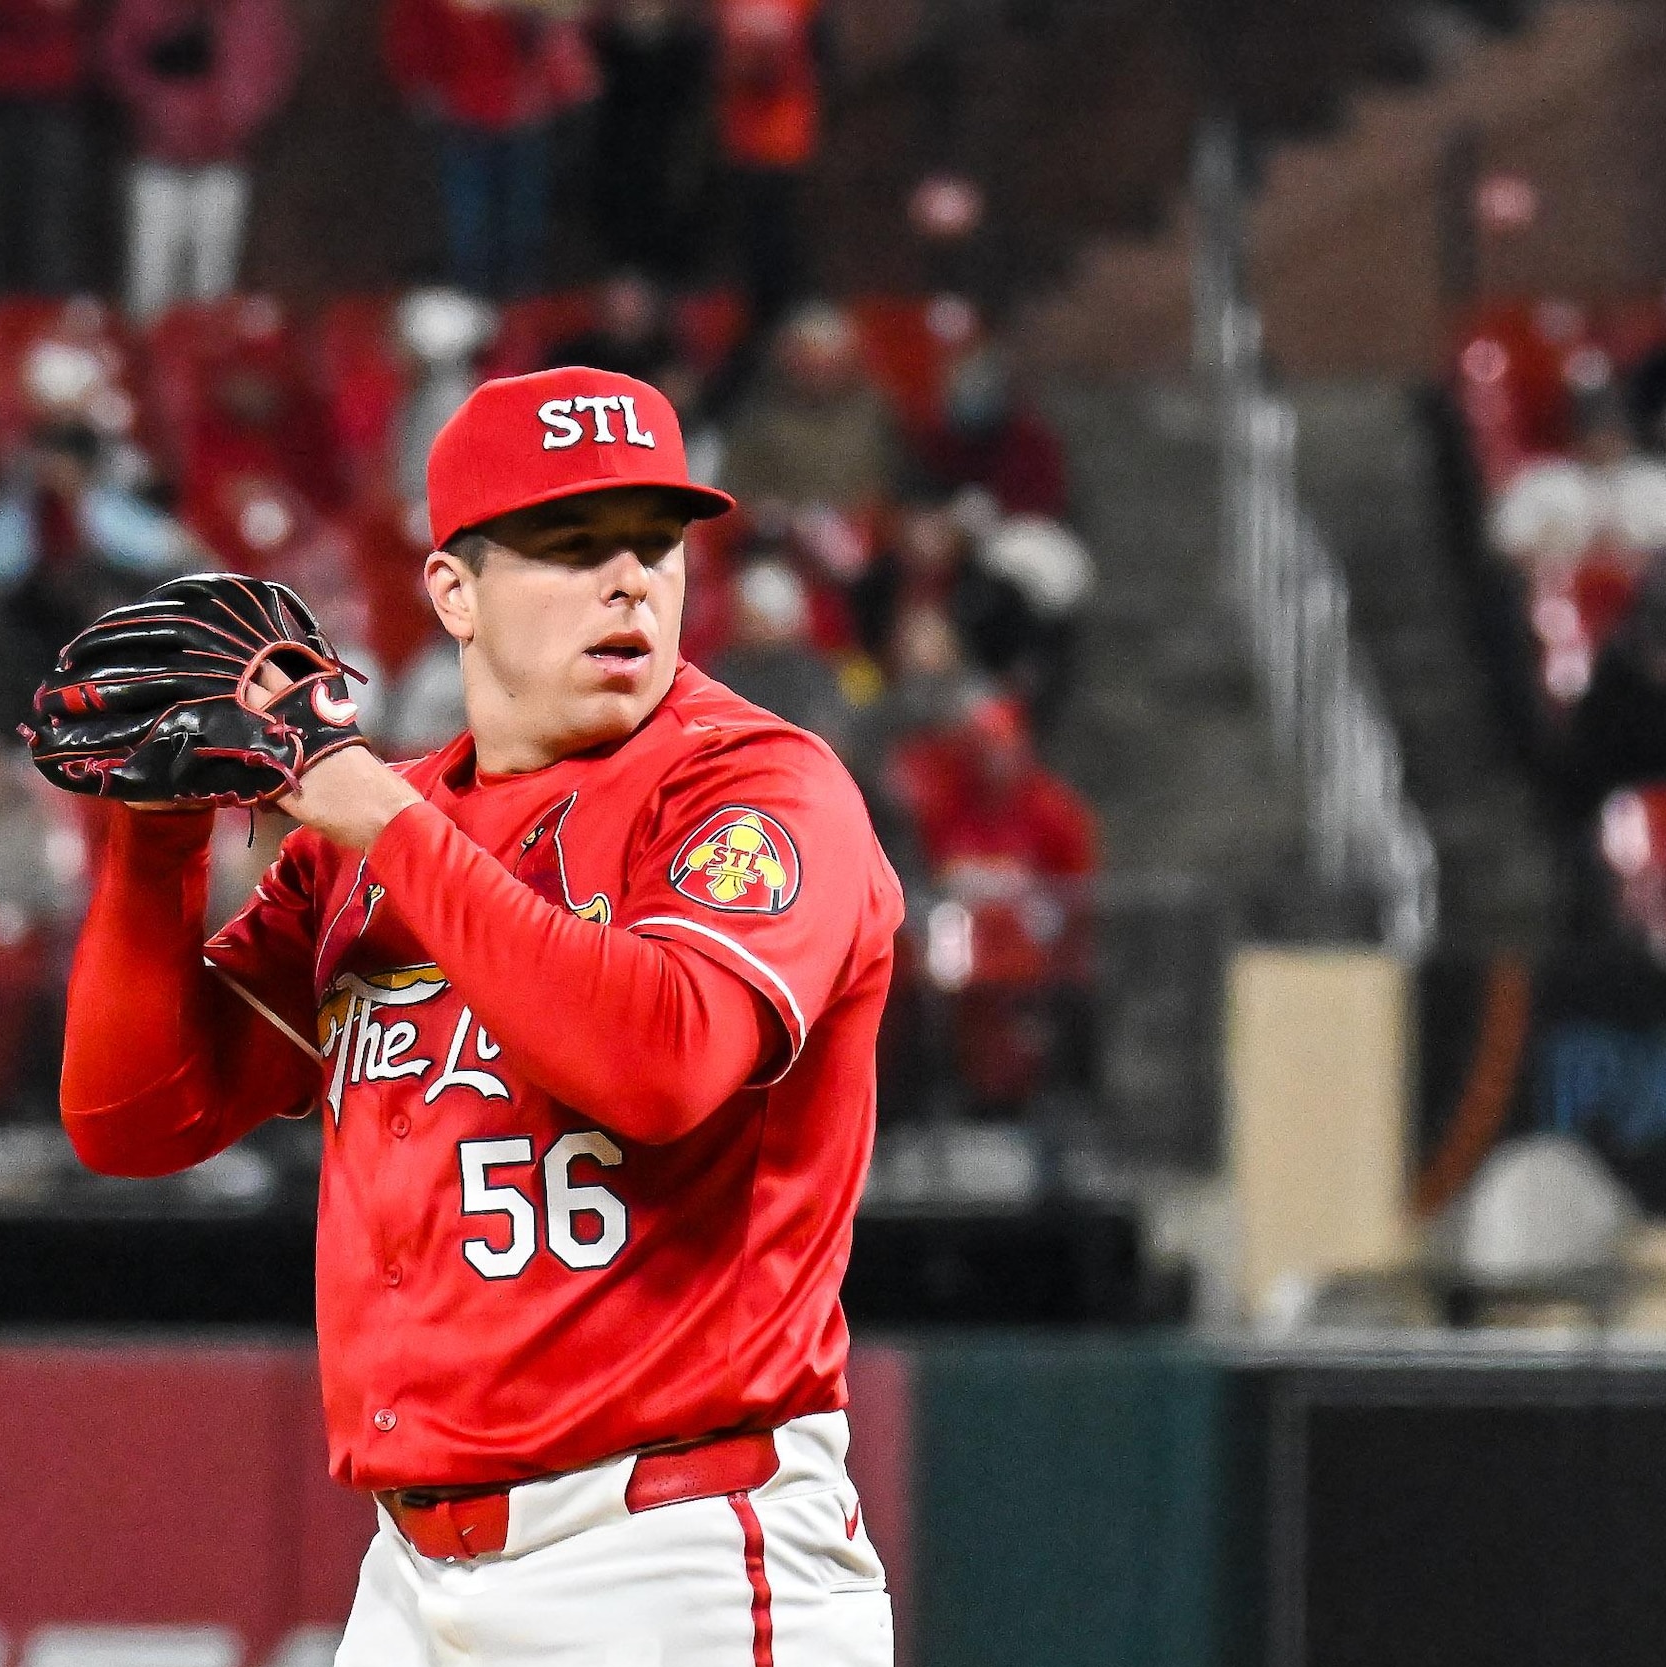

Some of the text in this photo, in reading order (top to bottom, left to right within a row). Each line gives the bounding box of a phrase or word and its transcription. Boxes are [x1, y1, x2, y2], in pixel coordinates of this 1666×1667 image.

[537, 394, 656, 451] STL
[709, 846, 763, 875] STL
[321, 972, 451, 1127] The
[458, 1130, 630, 1281] 56
